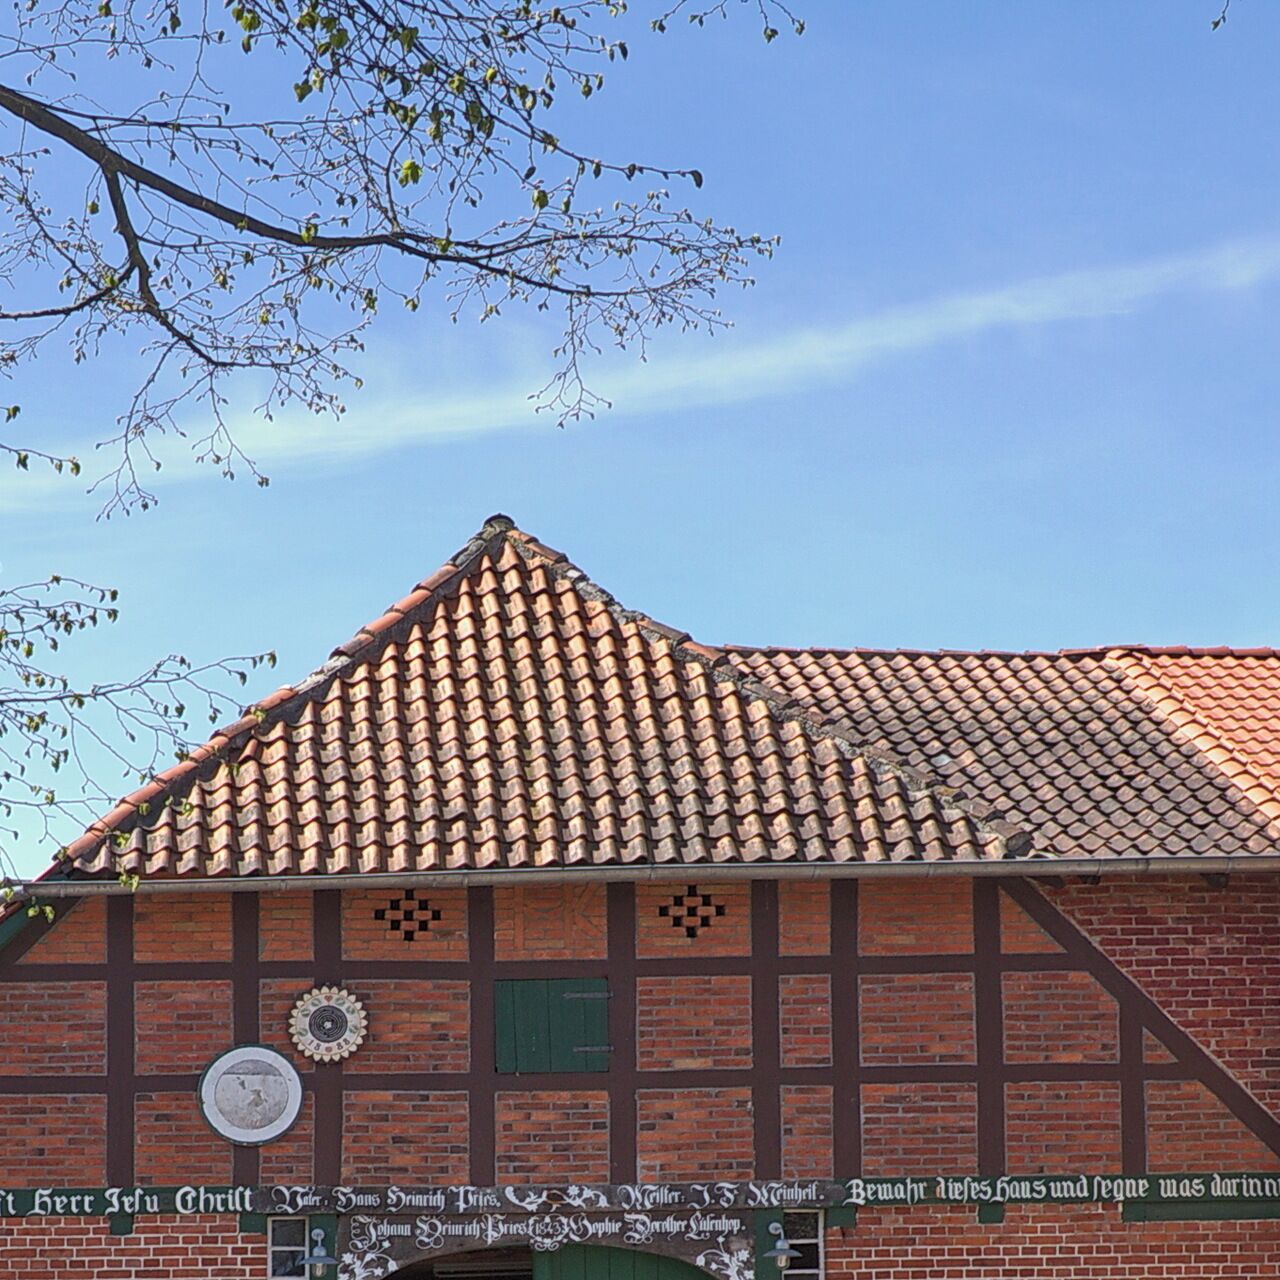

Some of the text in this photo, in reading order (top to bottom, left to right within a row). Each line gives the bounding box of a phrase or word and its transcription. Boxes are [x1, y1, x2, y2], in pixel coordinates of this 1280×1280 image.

[26, 1187, 95, 1216] Herr
[332, 1186, 381, 1213] Hans
[386, 1185, 446, 1213] Heinrich
[842, 1177, 929, 1206] Bewahr
[989, 1175, 1046, 1203] Haus
[1049, 1174, 1090, 1199] und
[1158, 1178, 1205, 1198] was
[349, 1214, 411, 1252] Johann
[415, 1214, 481, 1248] Heinrich
[535, 1221, 561, 1235] 1843
[569, 1213, 622, 1242] Sophie
